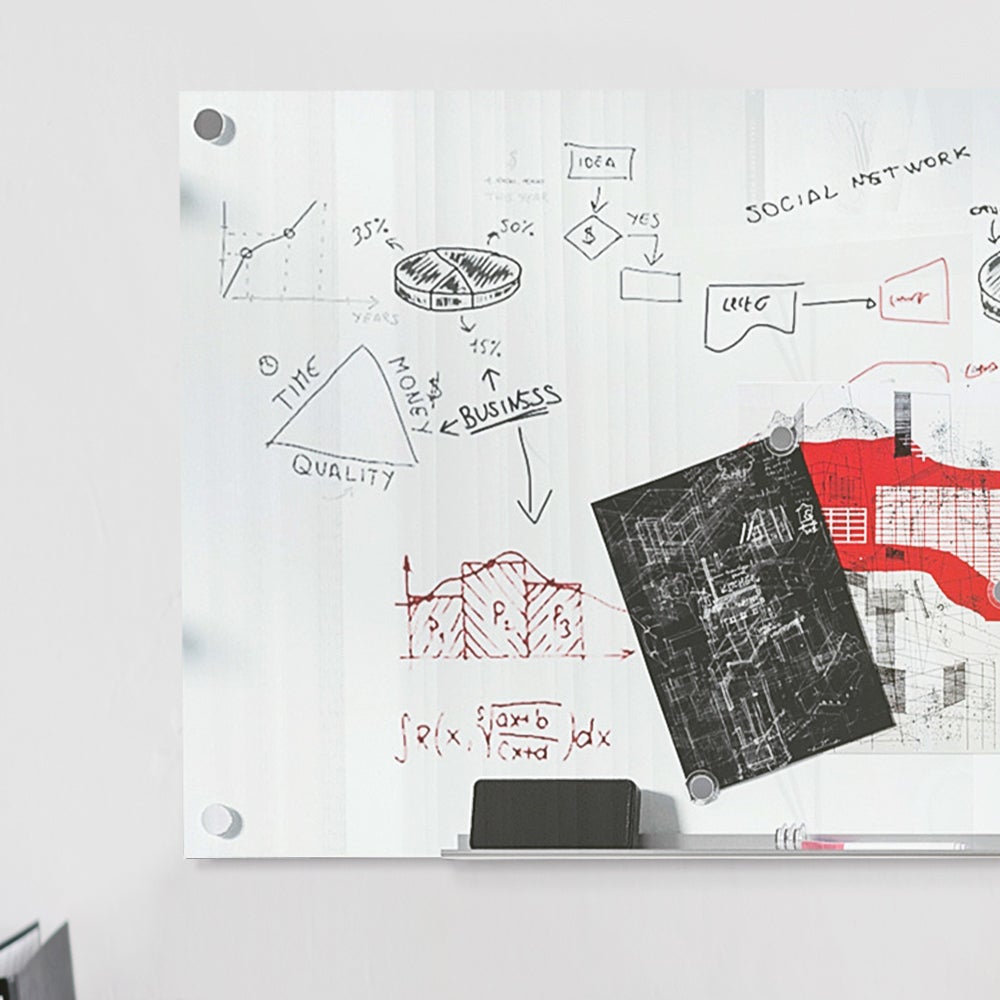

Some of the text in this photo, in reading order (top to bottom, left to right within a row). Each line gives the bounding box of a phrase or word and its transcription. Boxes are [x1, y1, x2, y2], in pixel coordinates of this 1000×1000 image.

[578, 156, 616, 169] IDEA
[745, 145, 972, 224] SOCIAL NETWORK
[351, 217, 390, 247] 35%
[500, 218, 535, 237] 50%
[626, 211, 661, 229] YES
[351, 311, 400, 326] YEARS
[469, 339, 502, 358] 15%
[271, 354, 320, 410] TIME
[388, 355, 434, 434] MONEY
[292, 453, 395, 492] QUALITY
